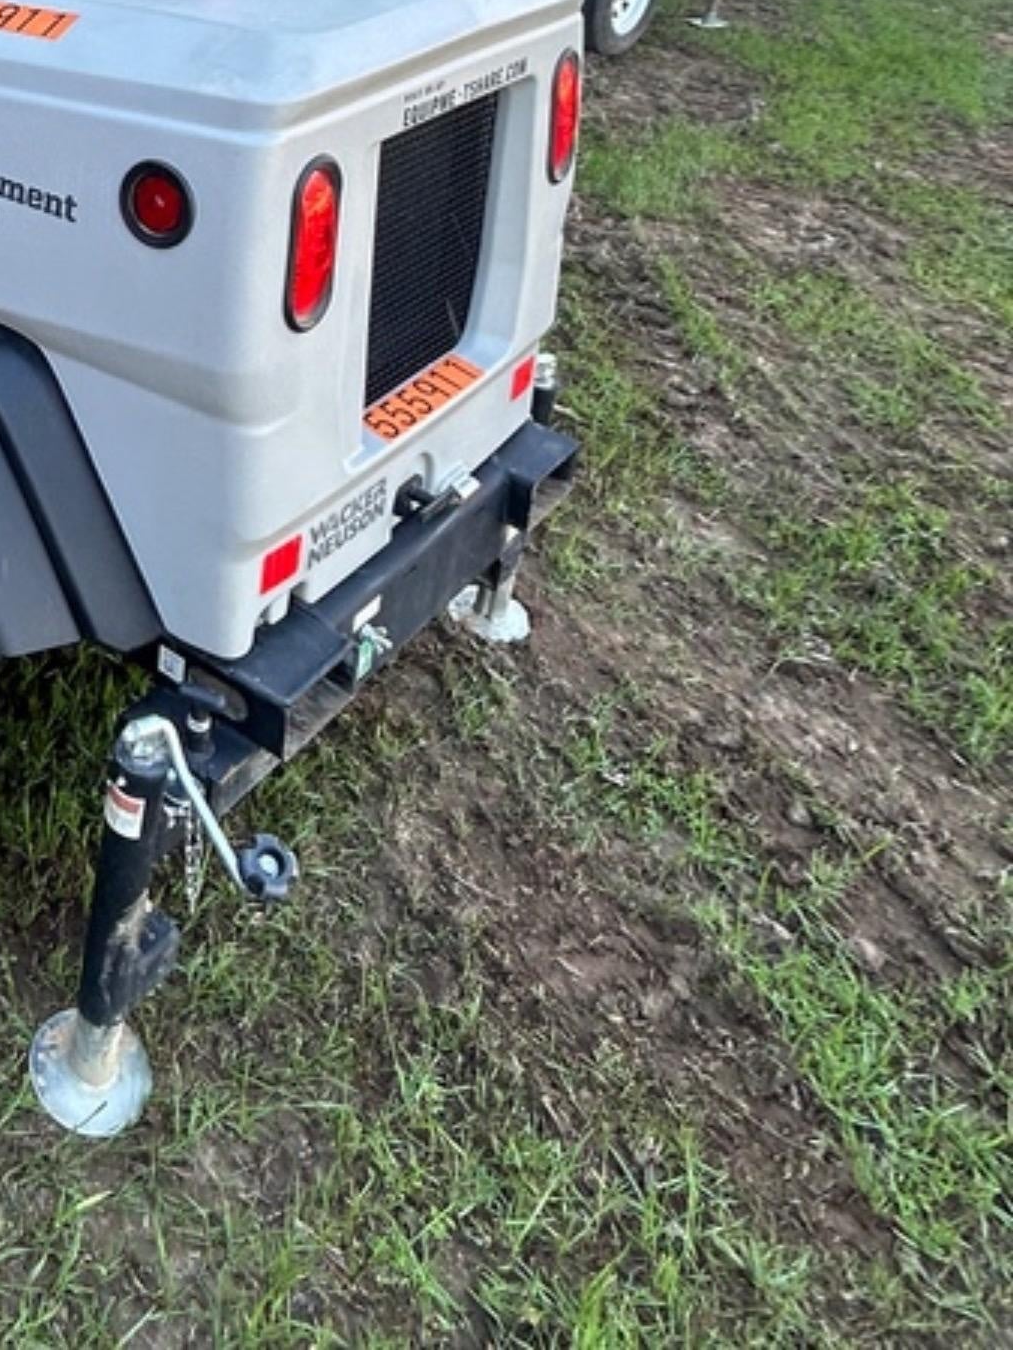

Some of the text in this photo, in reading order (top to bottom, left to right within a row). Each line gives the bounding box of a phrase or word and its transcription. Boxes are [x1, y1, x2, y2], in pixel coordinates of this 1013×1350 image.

[362, 358, 479, 439] 555911
[307, 496, 386, 571] NEUSON
[310, 476, 388, 544] WACKER
